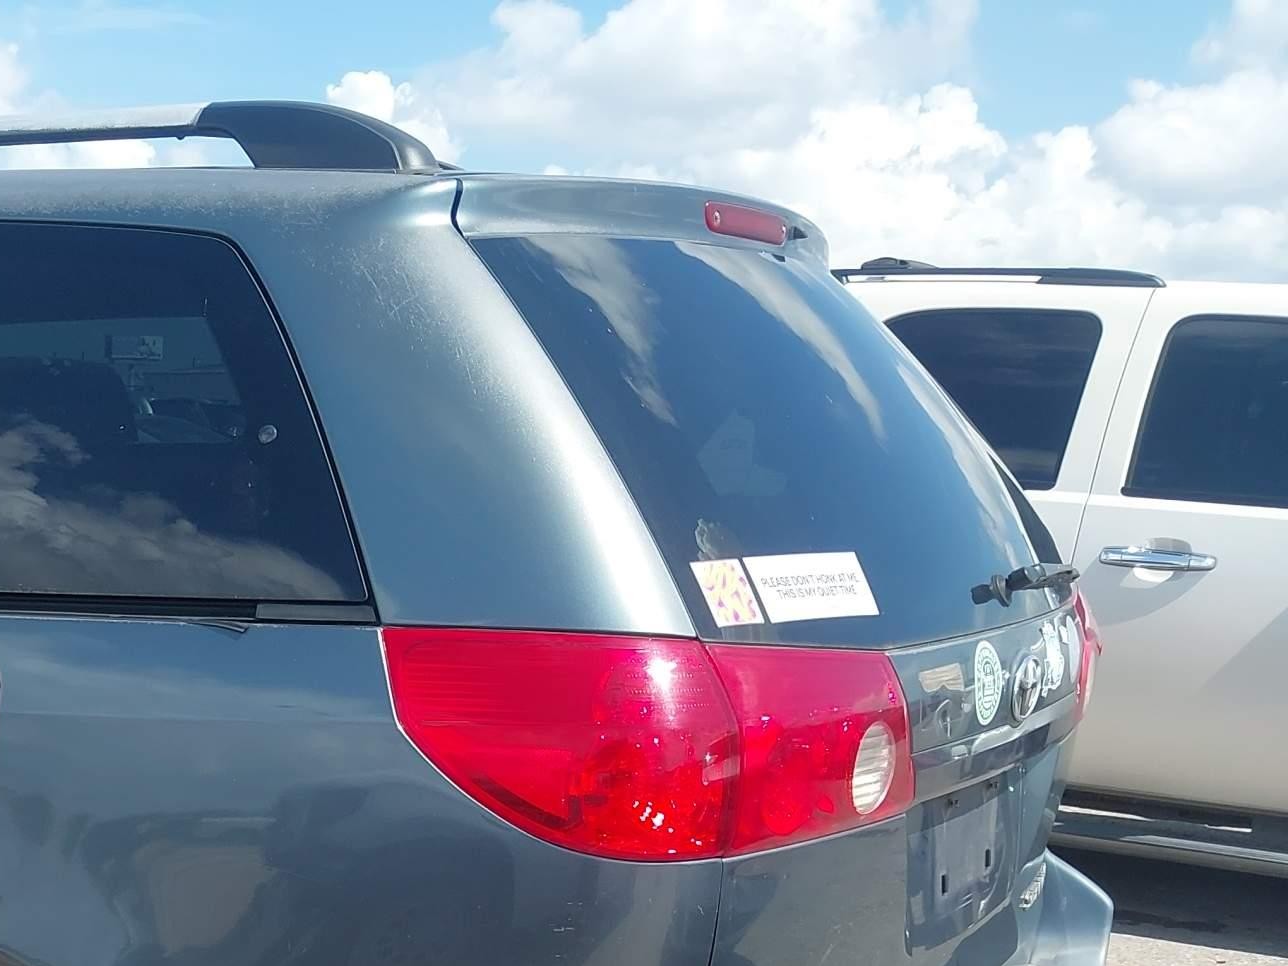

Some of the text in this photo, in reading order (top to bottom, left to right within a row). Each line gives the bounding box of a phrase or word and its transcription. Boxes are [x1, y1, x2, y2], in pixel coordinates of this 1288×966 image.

[760, 574, 792, 588] PLEASE
[791, 574, 815, 587] DON'T
[816, 573, 837, 585] HONK
[846, 571, 860, 583] ME
[775, 588, 796, 600] THIS
[816, 584, 838, 597] QUIET
[838, 583, 858, 596] TIME
